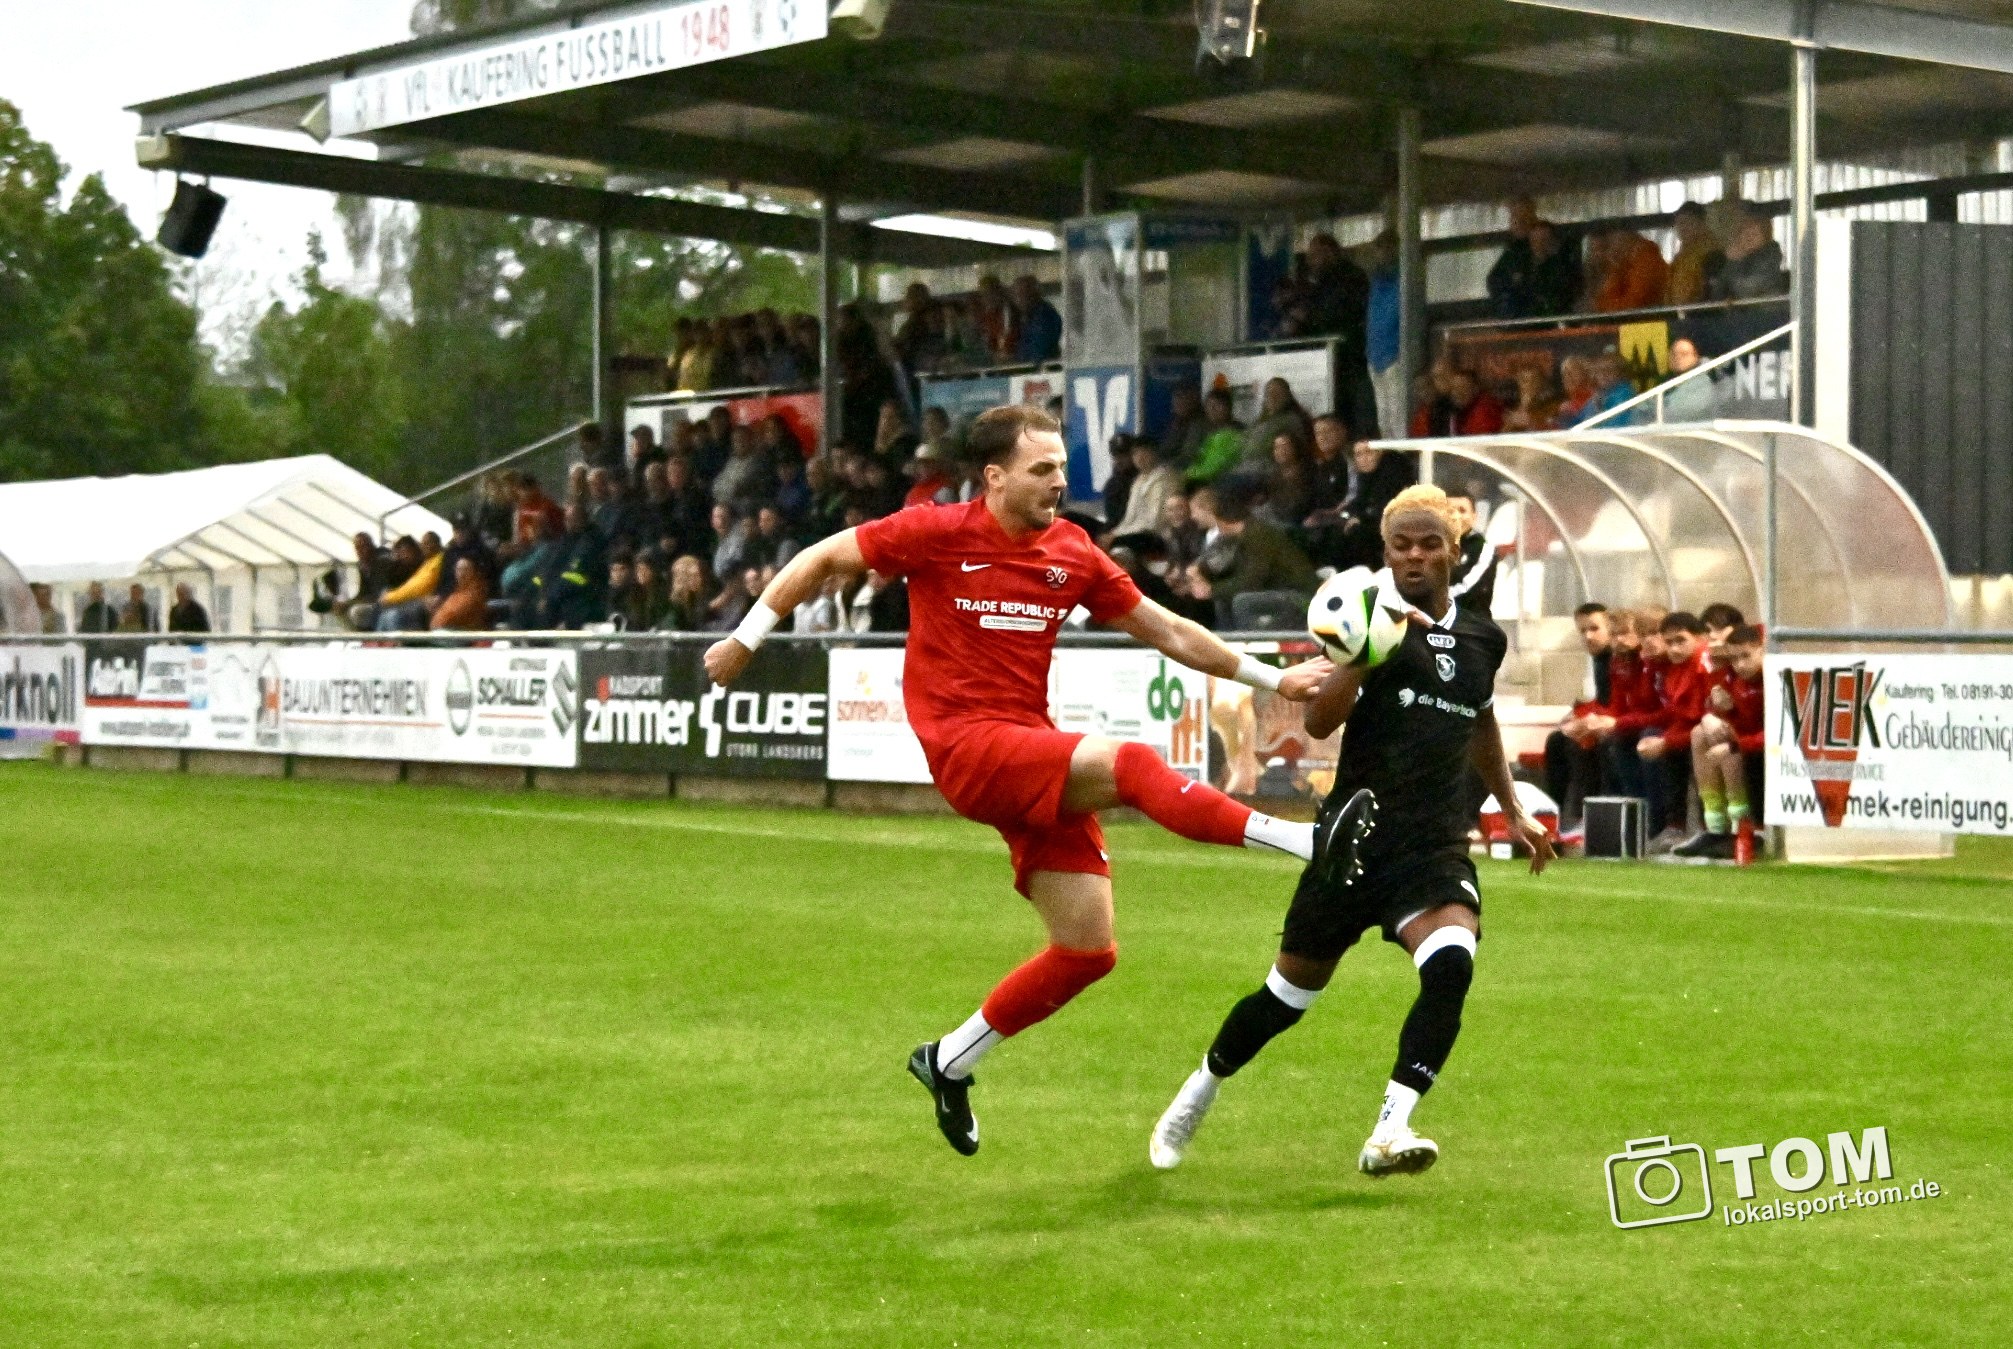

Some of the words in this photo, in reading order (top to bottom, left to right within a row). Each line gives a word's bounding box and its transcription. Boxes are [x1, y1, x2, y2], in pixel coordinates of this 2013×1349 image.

[447, 45, 548, 105] KAUFERING
[555, 20, 666, 84] FUSSBALL
[681, 4, 731, 57] 1948
[954, 598, 998, 613] TRADE
[1000, 601, 1056, 619] REPUBLIC
[0, 655, 76, 724] rknoll
[726, 691, 827, 735] CUBE
[1147, 657, 1185, 722] do
[1418, 693, 1435, 706] die
[584, 699, 695, 746] zimmer
